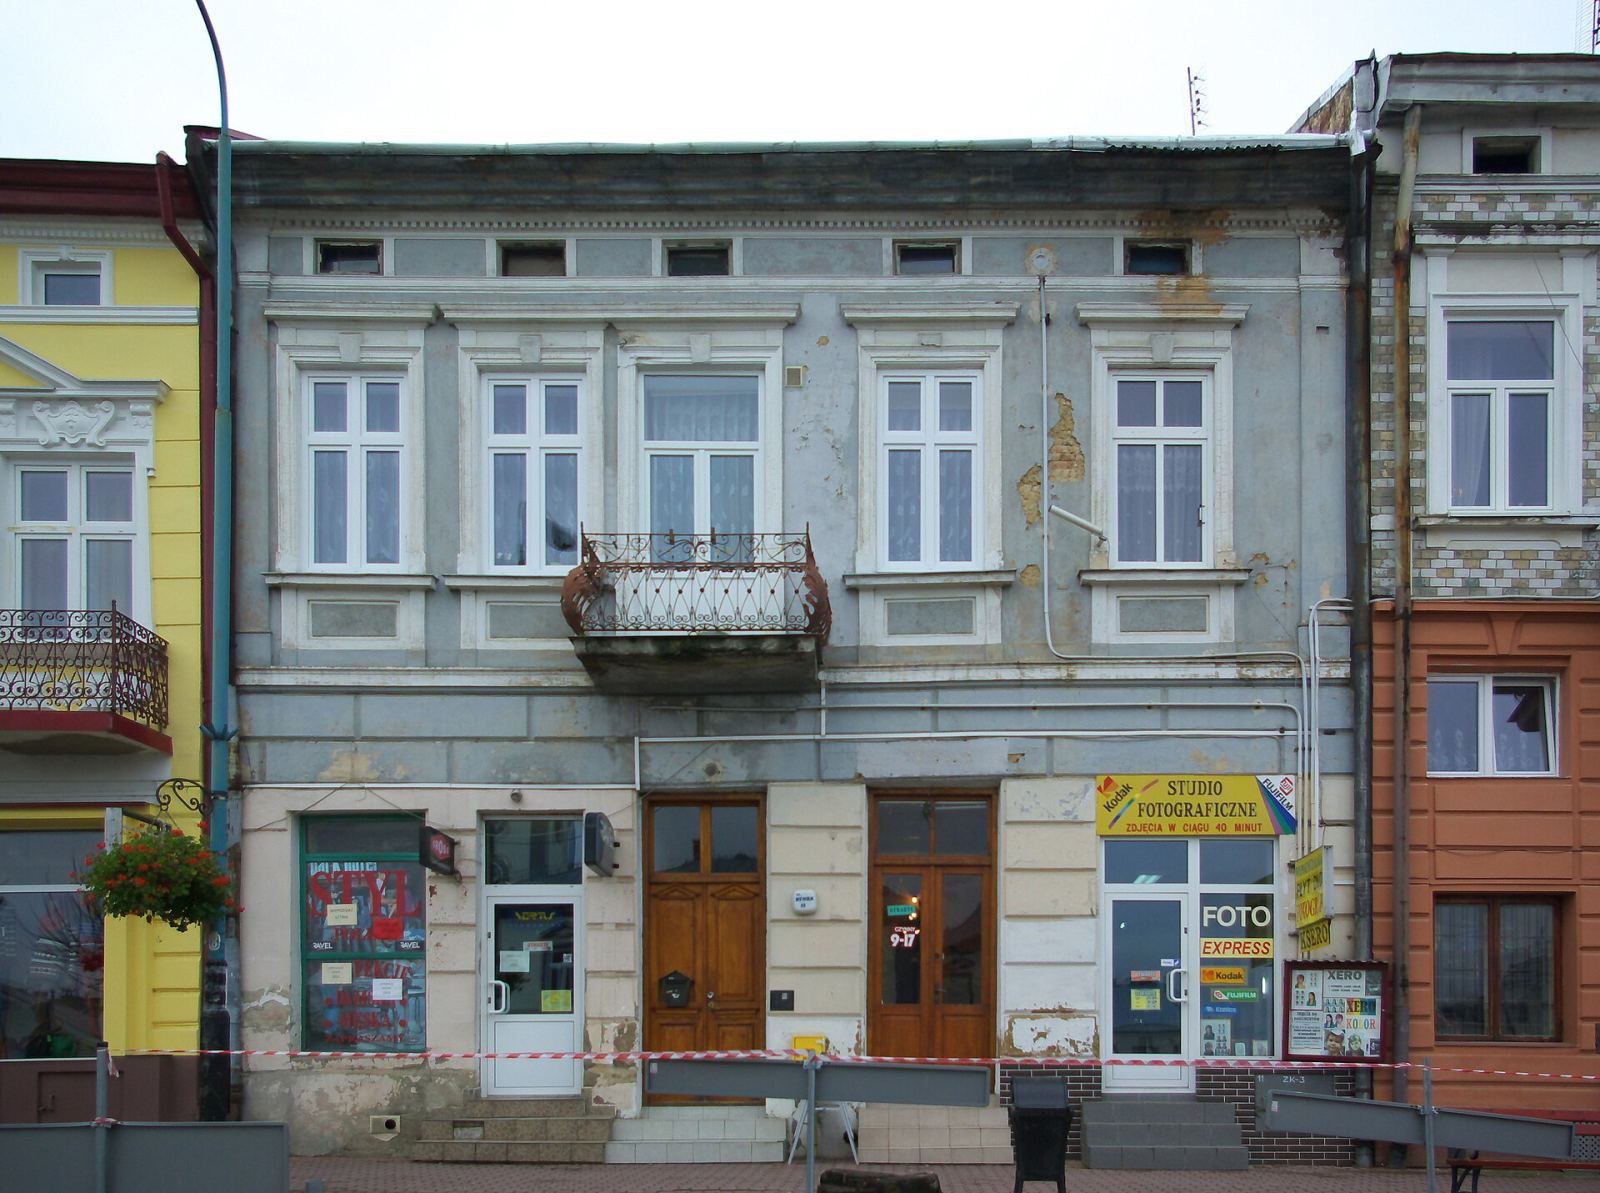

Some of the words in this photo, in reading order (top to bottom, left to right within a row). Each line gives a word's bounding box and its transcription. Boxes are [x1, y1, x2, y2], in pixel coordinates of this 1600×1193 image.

[1167, 780, 1223, 797] STUDIO
[1262, 777, 1294, 811] FUJIFILM
[1103, 782, 1133, 813] Kodak
[1137, 802, 1258, 818] FOTOGRAFICZNE
[1126, 822, 1163, 834] ZDJĘCIA
[1168, 823, 1176, 832] W
[1183, 823, 1209, 834] CIĄGU
[1215, 823, 1227, 832] 40
[1234, 822, 1263, 832] MINUT
[308, 868, 423, 917] STYL
[1203, 905, 1271, 927] FOTO
[890, 933, 916, 947] 9-17
[1300, 922, 1329, 950] KSERO
[1202, 941, 1271, 955] EXPRESS
[1215, 972, 1244, 980] Kodak
[1327, 970, 1362, 980] XERO
[1346, 998, 1376, 1014] XERO
[1346, 1019, 1376, 1030] KOLOR
[1282, 1075, 1305, 1084] ZK-3
